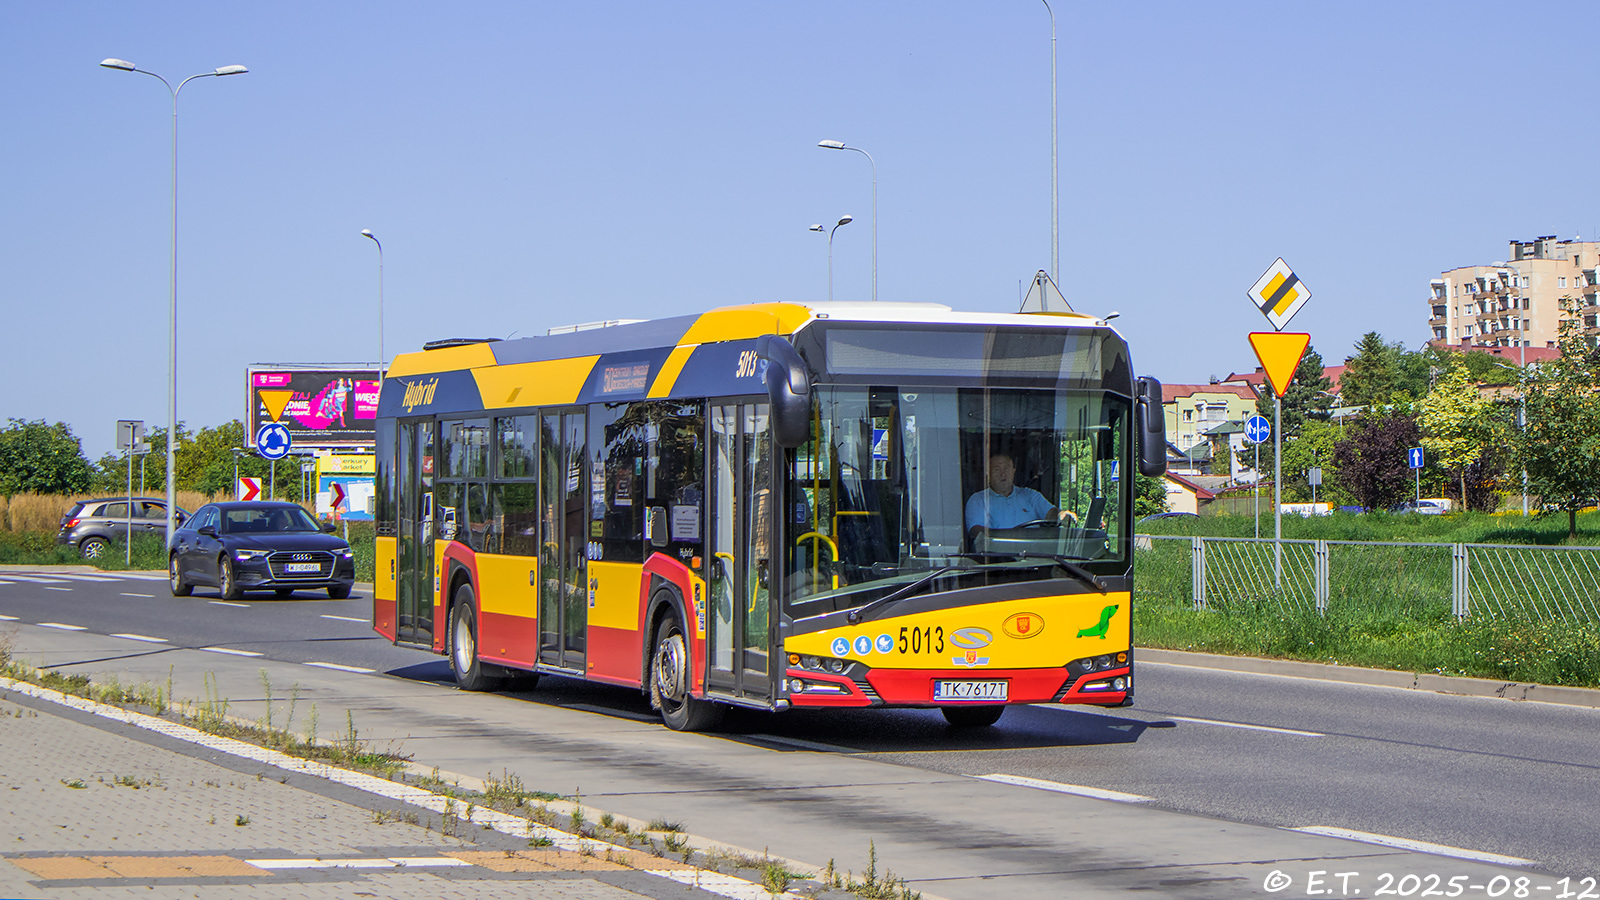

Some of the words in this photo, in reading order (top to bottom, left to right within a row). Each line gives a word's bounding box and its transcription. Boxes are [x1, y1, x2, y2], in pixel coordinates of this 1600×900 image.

[736, 350, 759, 378] 5013
[401, 377, 440, 414] Hybrid
[679, 547, 694, 559] Hybrid
[898, 625, 945, 655] 5013
[943, 682, 962, 696] TK
[966, 682, 1006, 696] 7617T
